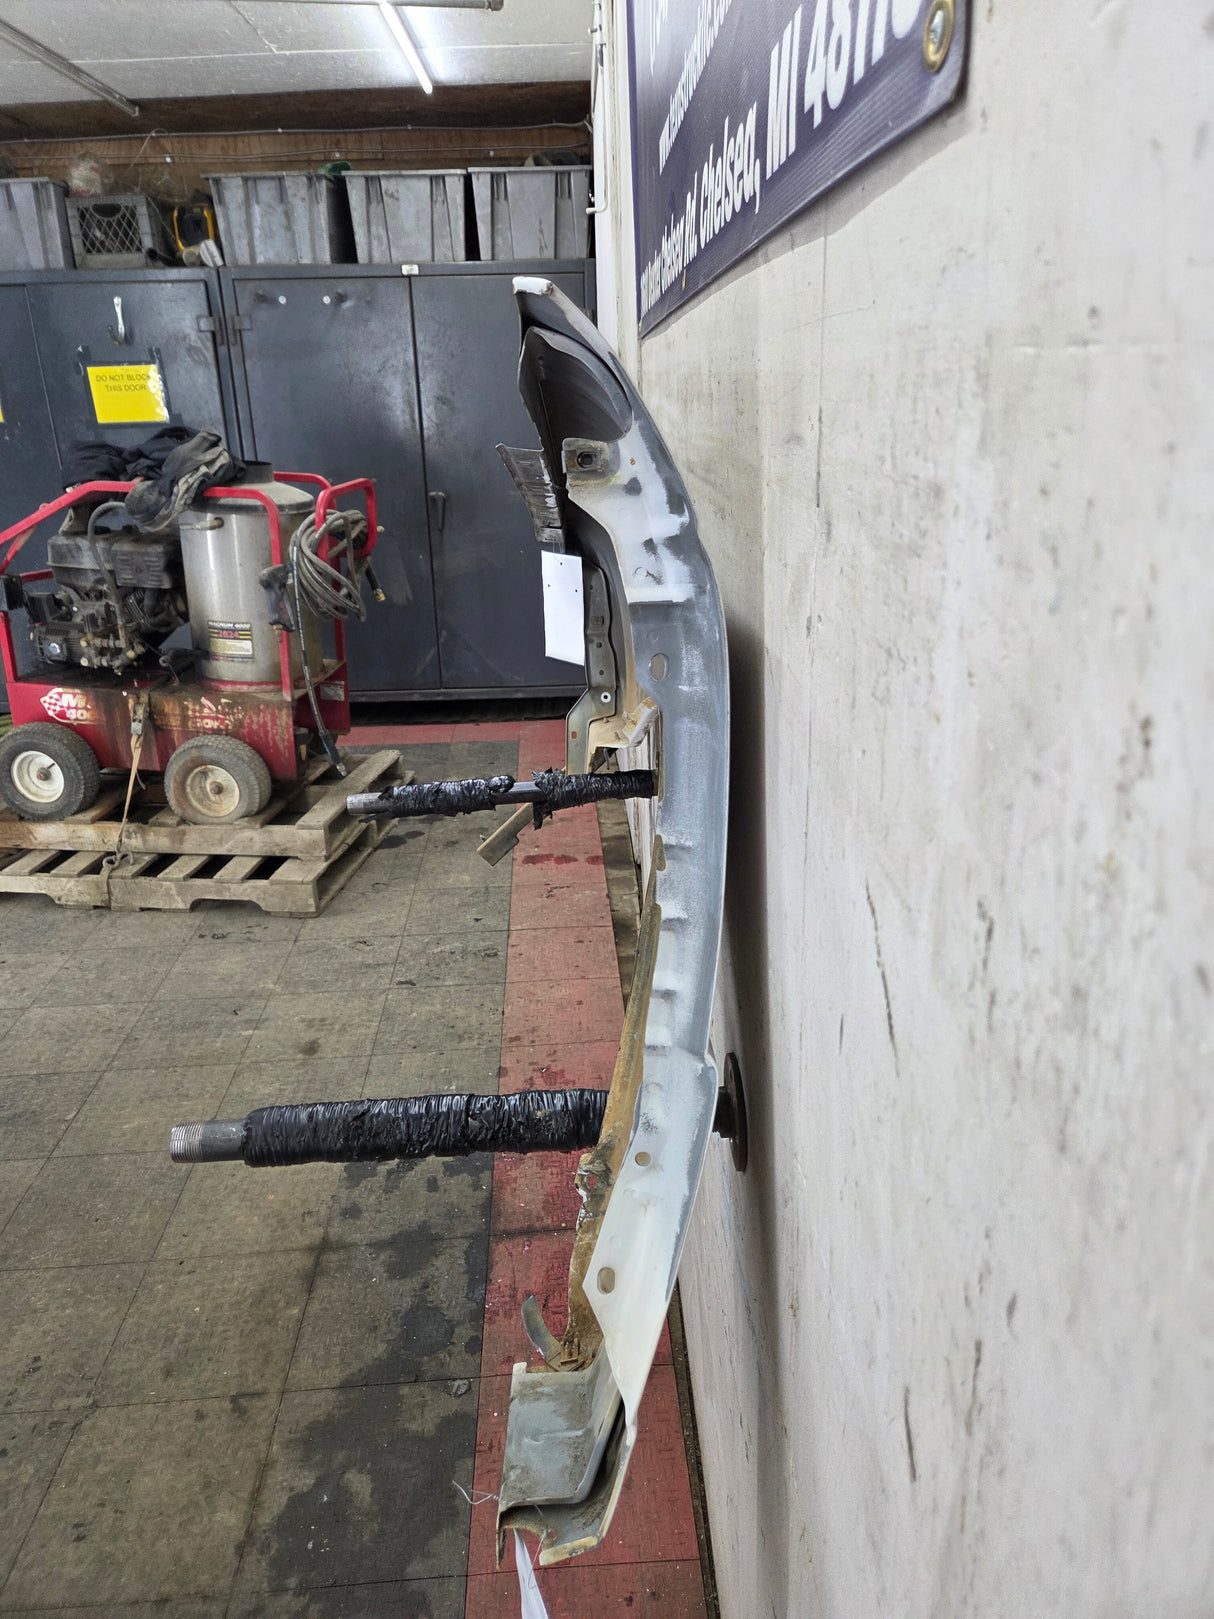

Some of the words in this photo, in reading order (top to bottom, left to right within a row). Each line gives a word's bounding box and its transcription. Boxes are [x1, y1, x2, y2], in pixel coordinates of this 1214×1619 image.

[684, 170, 698, 268] Rd.
[700, 101, 761, 250] Chelsea,
[766, 3, 802, 181] MI
[804, 0, 922, 130] 481
[95, 374, 108, 382] DO
[105, 384, 123, 392] THIS
[124, 384, 147, 392] DOOR
